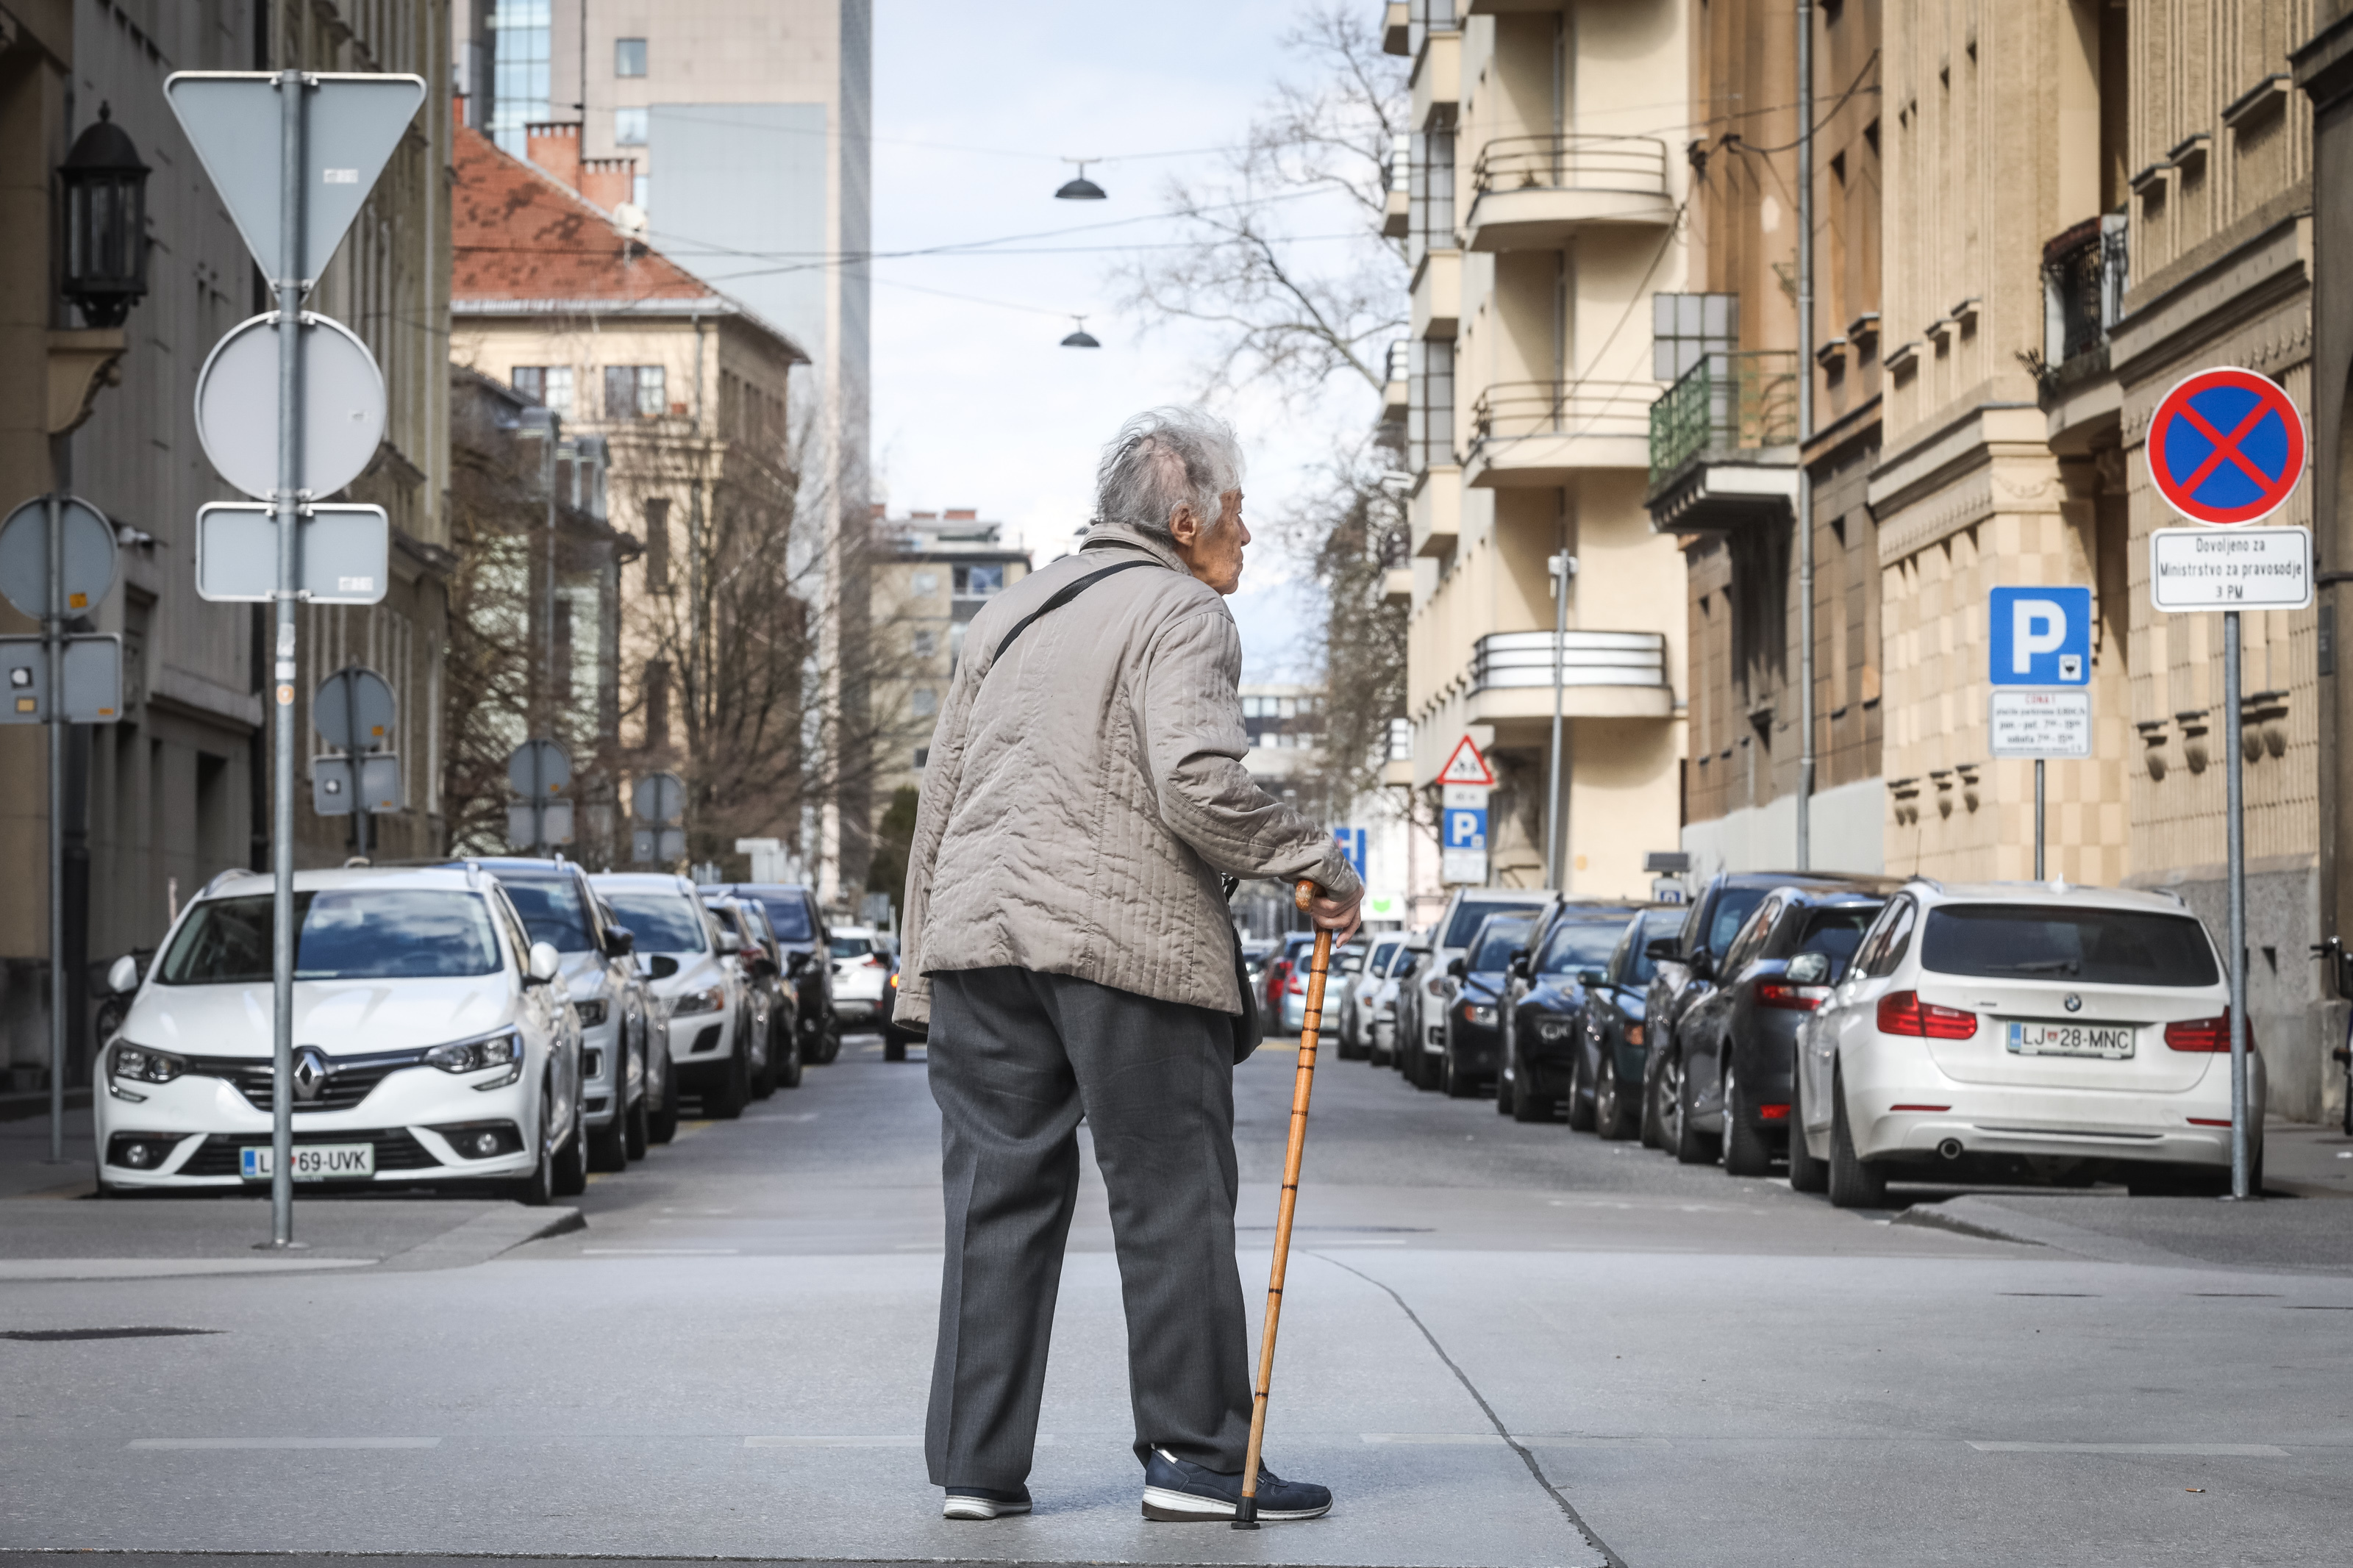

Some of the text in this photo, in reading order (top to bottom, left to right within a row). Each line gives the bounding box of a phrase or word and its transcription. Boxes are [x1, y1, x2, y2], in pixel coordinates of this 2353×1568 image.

[2196, 537, 2265, 555] Dovoljeno za
[2160, 560, 2302, 579] Ministrstvo za pravosodje
[2227, 584, 2243, 599] PM
[2013, 599, 2067, 674] P
[1452, 812, 1478, 845] P
[2023, 1027, 2045, 1046] LJ
